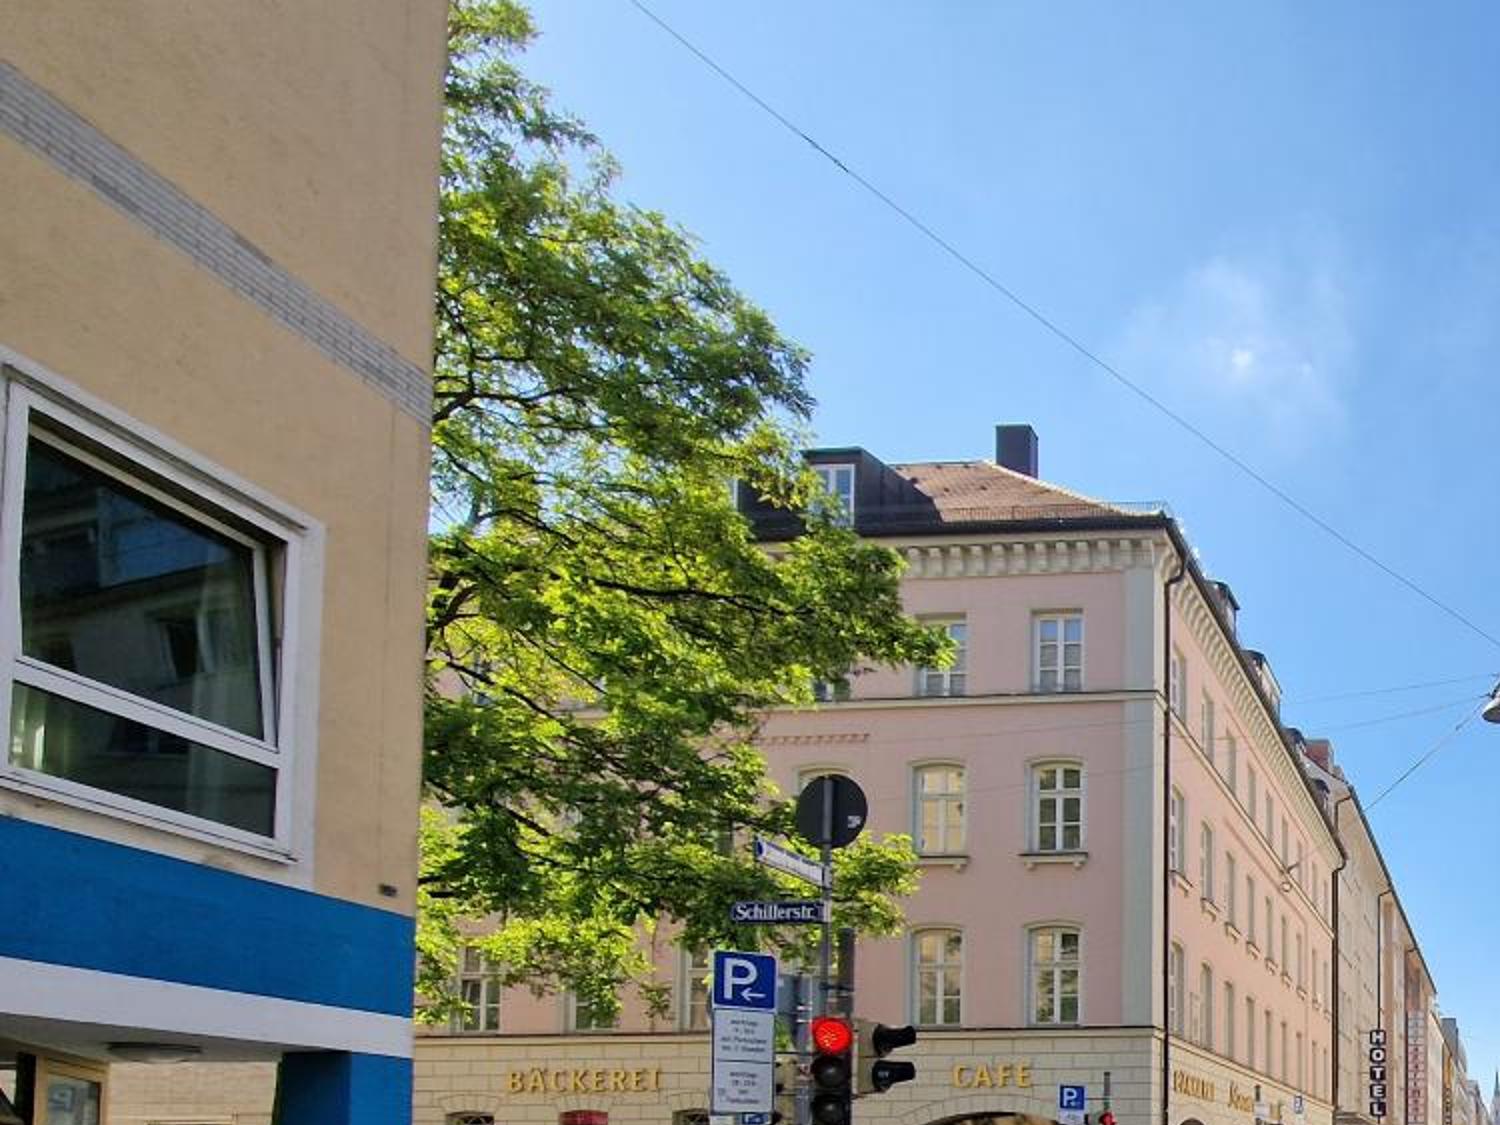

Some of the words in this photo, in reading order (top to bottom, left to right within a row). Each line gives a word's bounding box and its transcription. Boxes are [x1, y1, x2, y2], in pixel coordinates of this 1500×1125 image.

[736, 904, 816, 921] Schillerstr.
[723, 957, 758, 1000] P
[507, 1065, 662, 1094] BÄCKEREI
[1371, 1031, 1385, 1116] HOTEL
